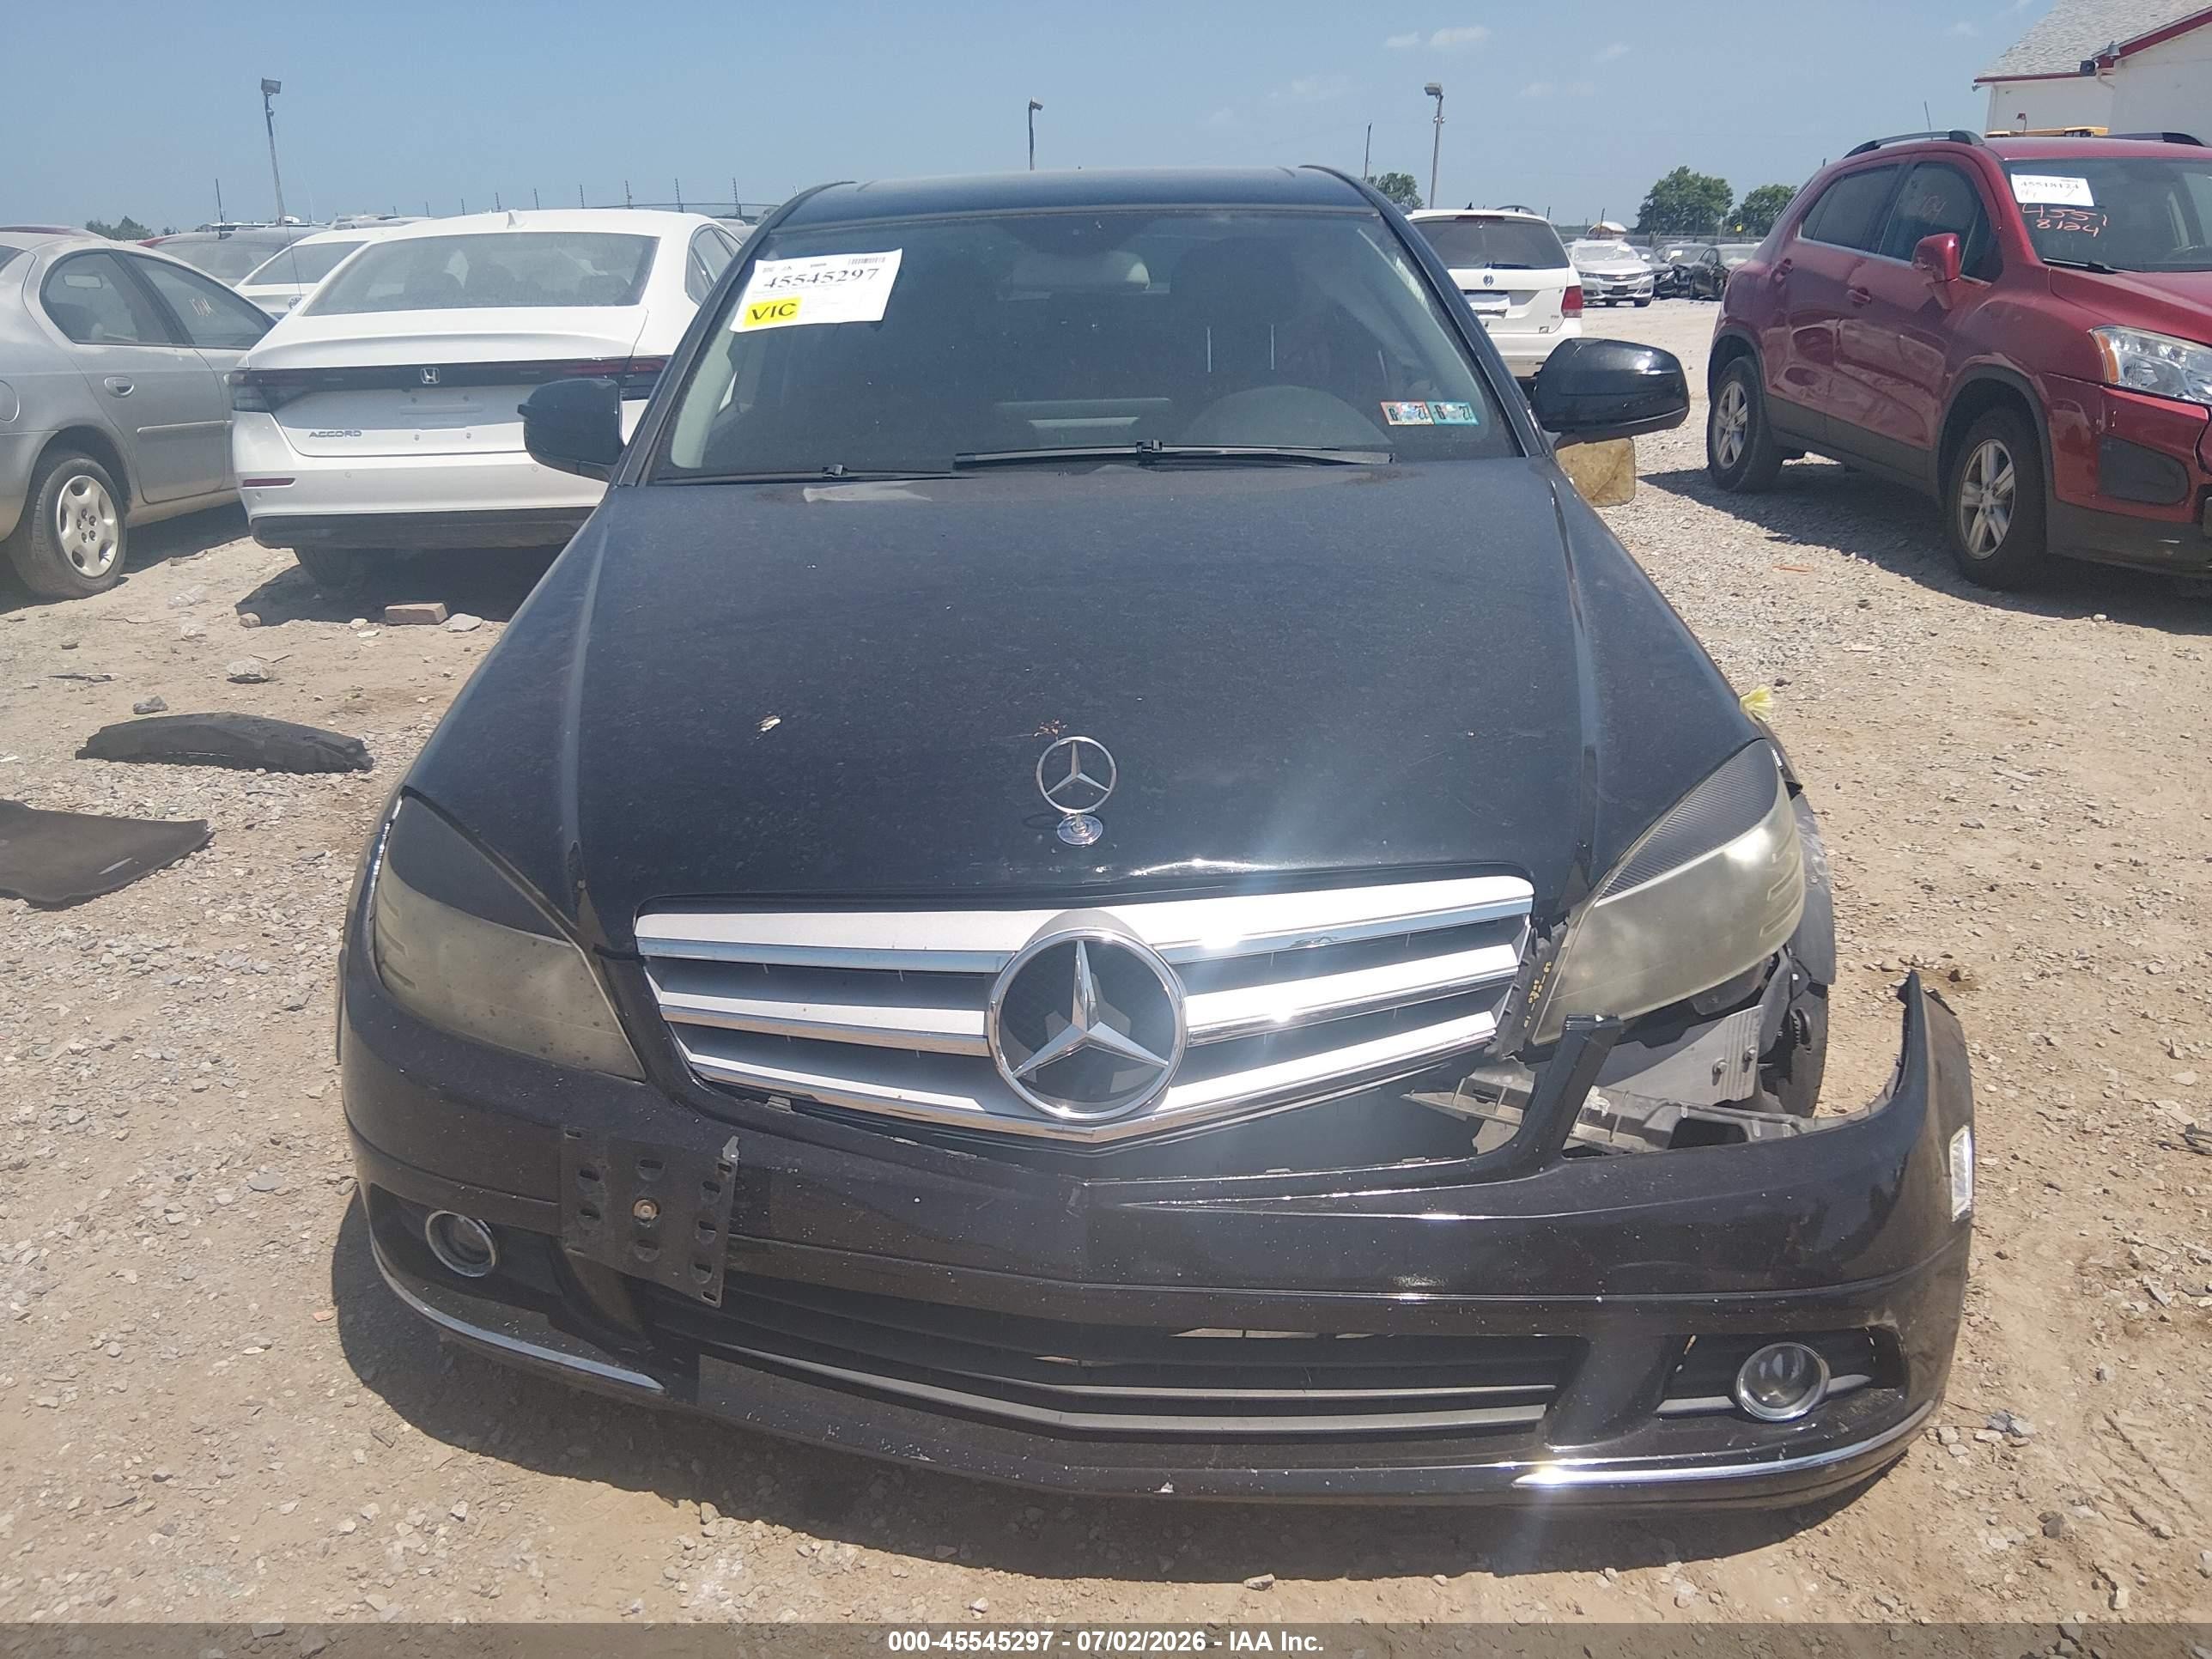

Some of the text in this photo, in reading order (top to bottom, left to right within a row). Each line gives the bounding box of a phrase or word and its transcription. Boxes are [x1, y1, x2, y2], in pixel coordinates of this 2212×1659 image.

[763, 267, 880, 289] 45545297
[751, 302, 798, 321] VIC
[308, 430, 363, 439] ACCORD
